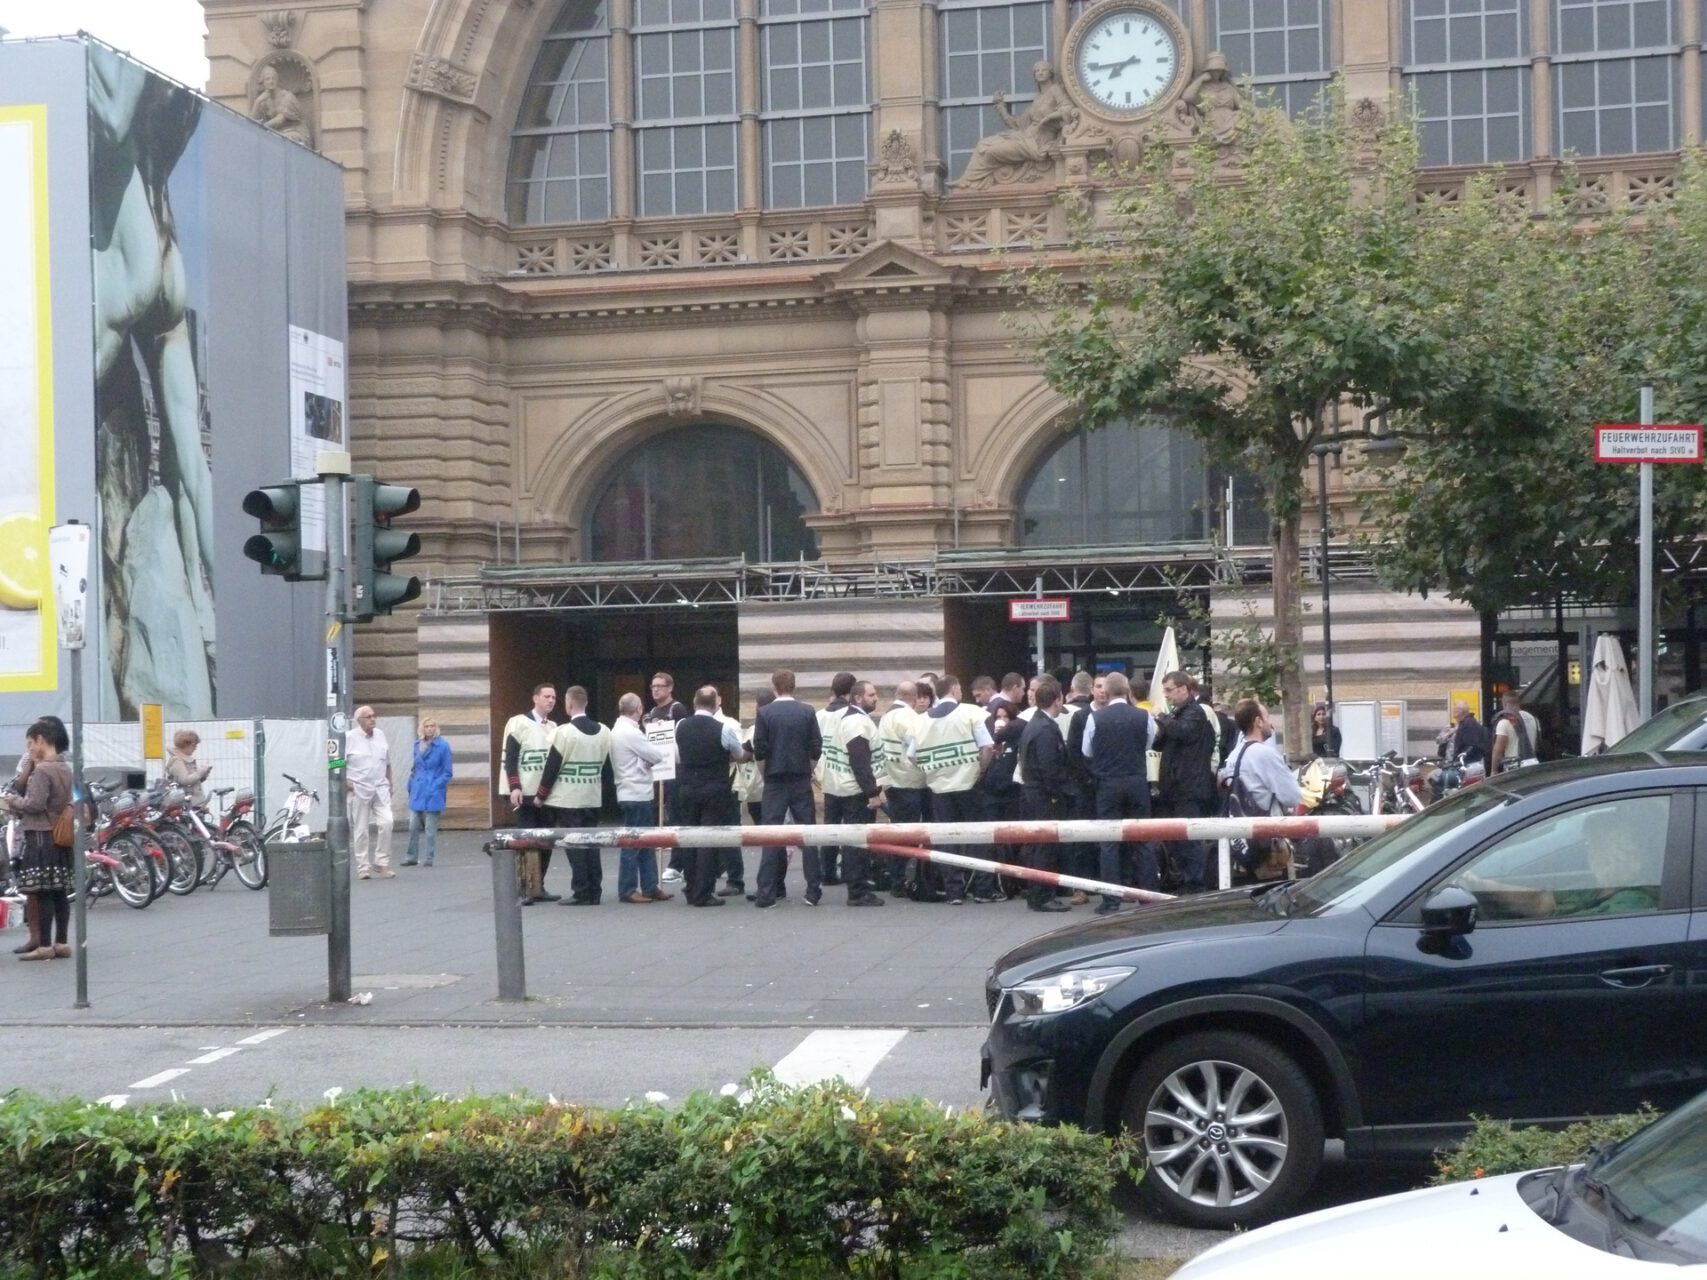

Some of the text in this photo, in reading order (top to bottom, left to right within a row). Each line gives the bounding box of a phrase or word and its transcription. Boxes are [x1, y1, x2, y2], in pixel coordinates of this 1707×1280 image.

[1601, 432, 1696, 443] FEUERWEHRZUFAHRT
[1612, 446, 1648, 454] Haltverbot
[1650, 446, 1667, 454] nach
